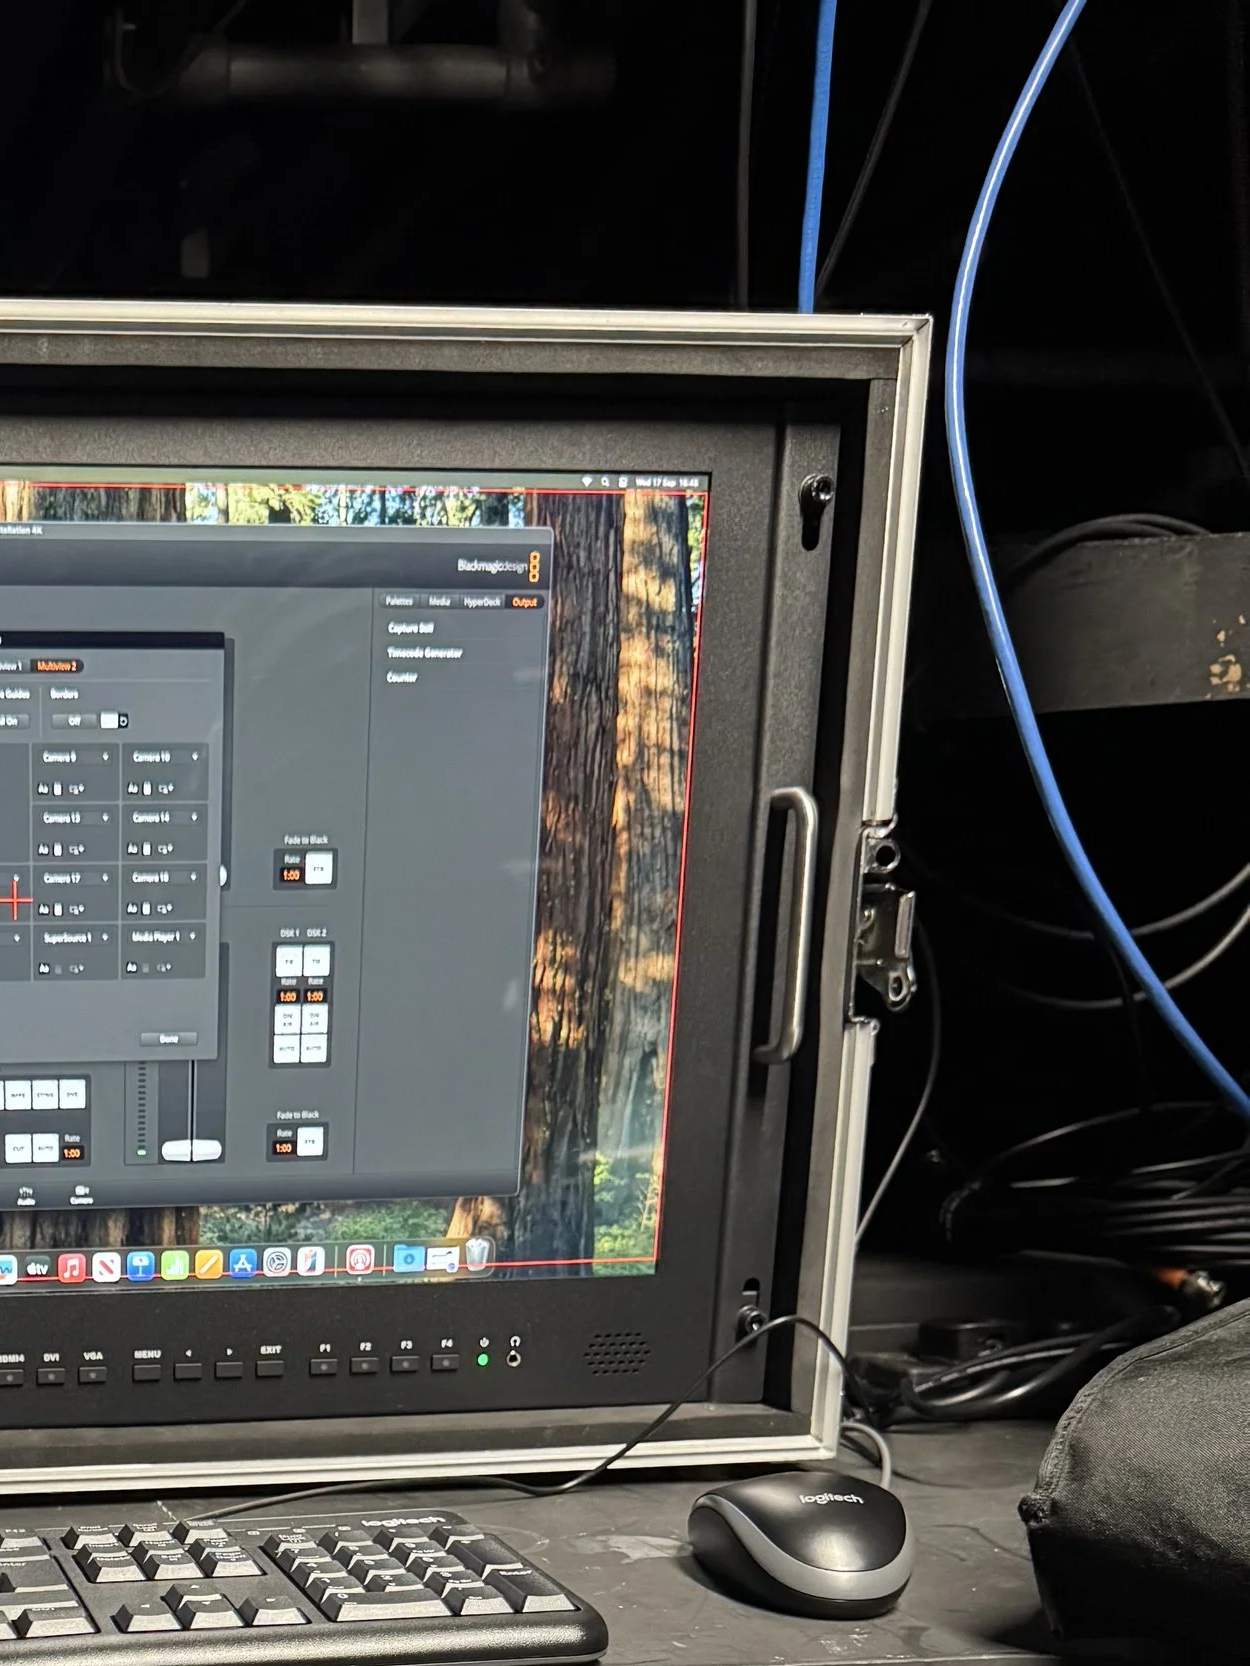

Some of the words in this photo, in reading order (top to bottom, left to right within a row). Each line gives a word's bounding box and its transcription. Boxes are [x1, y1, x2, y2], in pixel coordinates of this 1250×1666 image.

[512, 597, 538, 609] Output
[280, 991, 296, 1002] 1:00
[307, 991, 324, 1002] 1:00
[276, 1143, 292, 1152] 1:00
[63, 1149, 81, 1159] 1:00
[319, 1343, 331, 1353] F1
[359, 1341, 371, 1351] F2
[400, 1340, 412, 1350] F3
[441, 1338, 453, 1349] F4
[134, 1350, 162, 1360] MENU
[260, 1345, 282, 1355] EXIT
[43, 1353, 60, 1362] DVI
[83, 1351, 103, 1361] VGA
[799, 1493, 864, 1505] logitech
[361, 1516, 446, 1528] logitech
